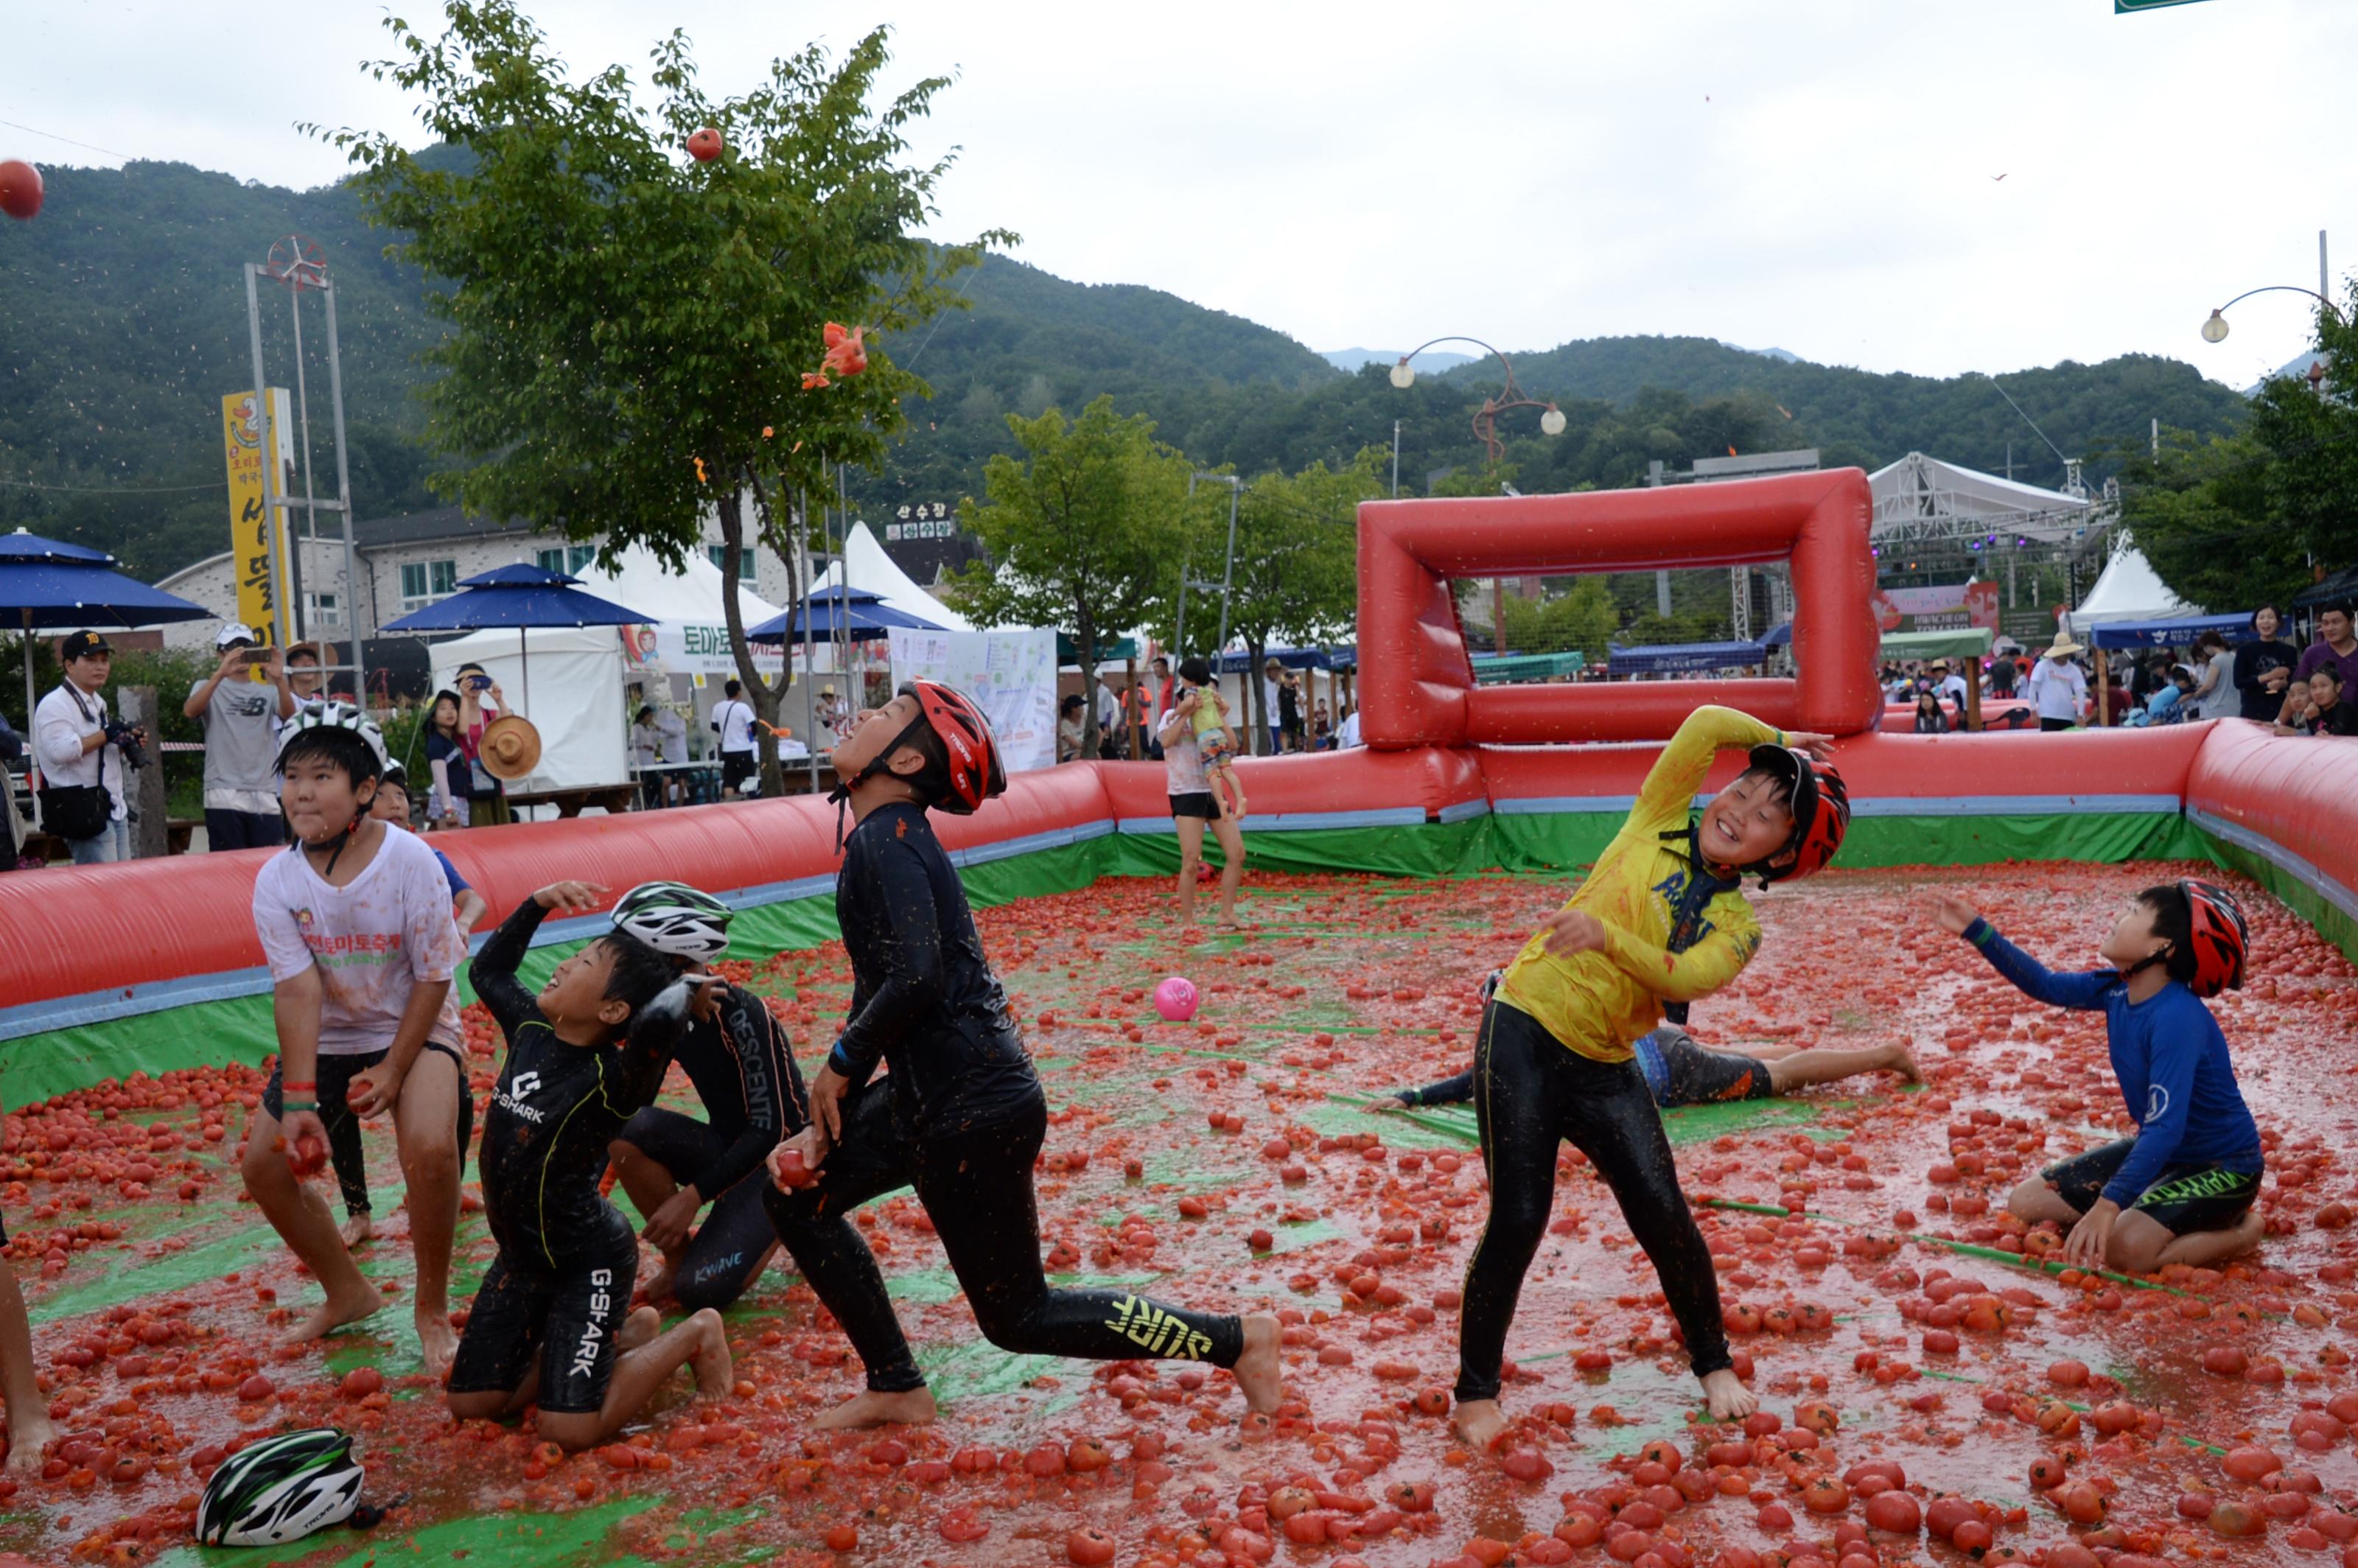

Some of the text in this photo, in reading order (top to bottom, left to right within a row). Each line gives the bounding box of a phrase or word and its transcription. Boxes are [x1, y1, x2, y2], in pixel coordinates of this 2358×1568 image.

[897, 503, 946, 520] 산수장
[695, 1251, 744, 1286] KWAVE
[1105, 1293, 1214, 1362] SURF
